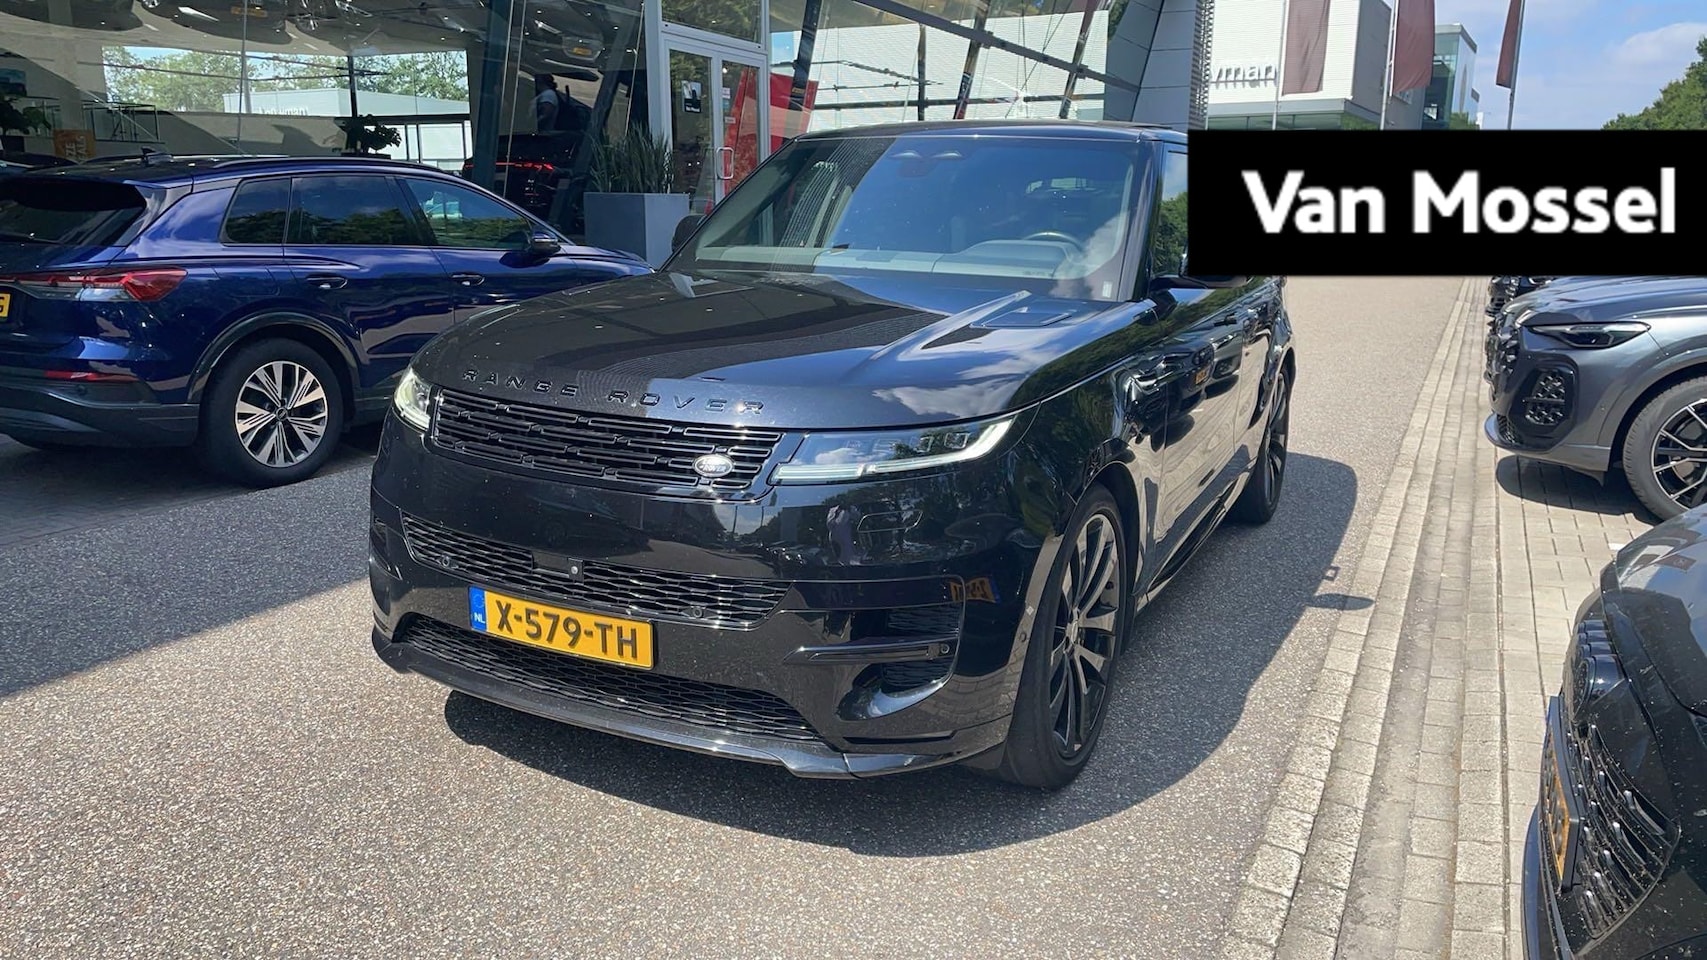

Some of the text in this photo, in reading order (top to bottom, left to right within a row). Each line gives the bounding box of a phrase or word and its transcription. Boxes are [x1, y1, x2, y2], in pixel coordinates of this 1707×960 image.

[462, 369, 765, 415] RANGE ROVER
[474, 612, 486, 625] NL
[495, 600, 638, 660] X-579-TH
